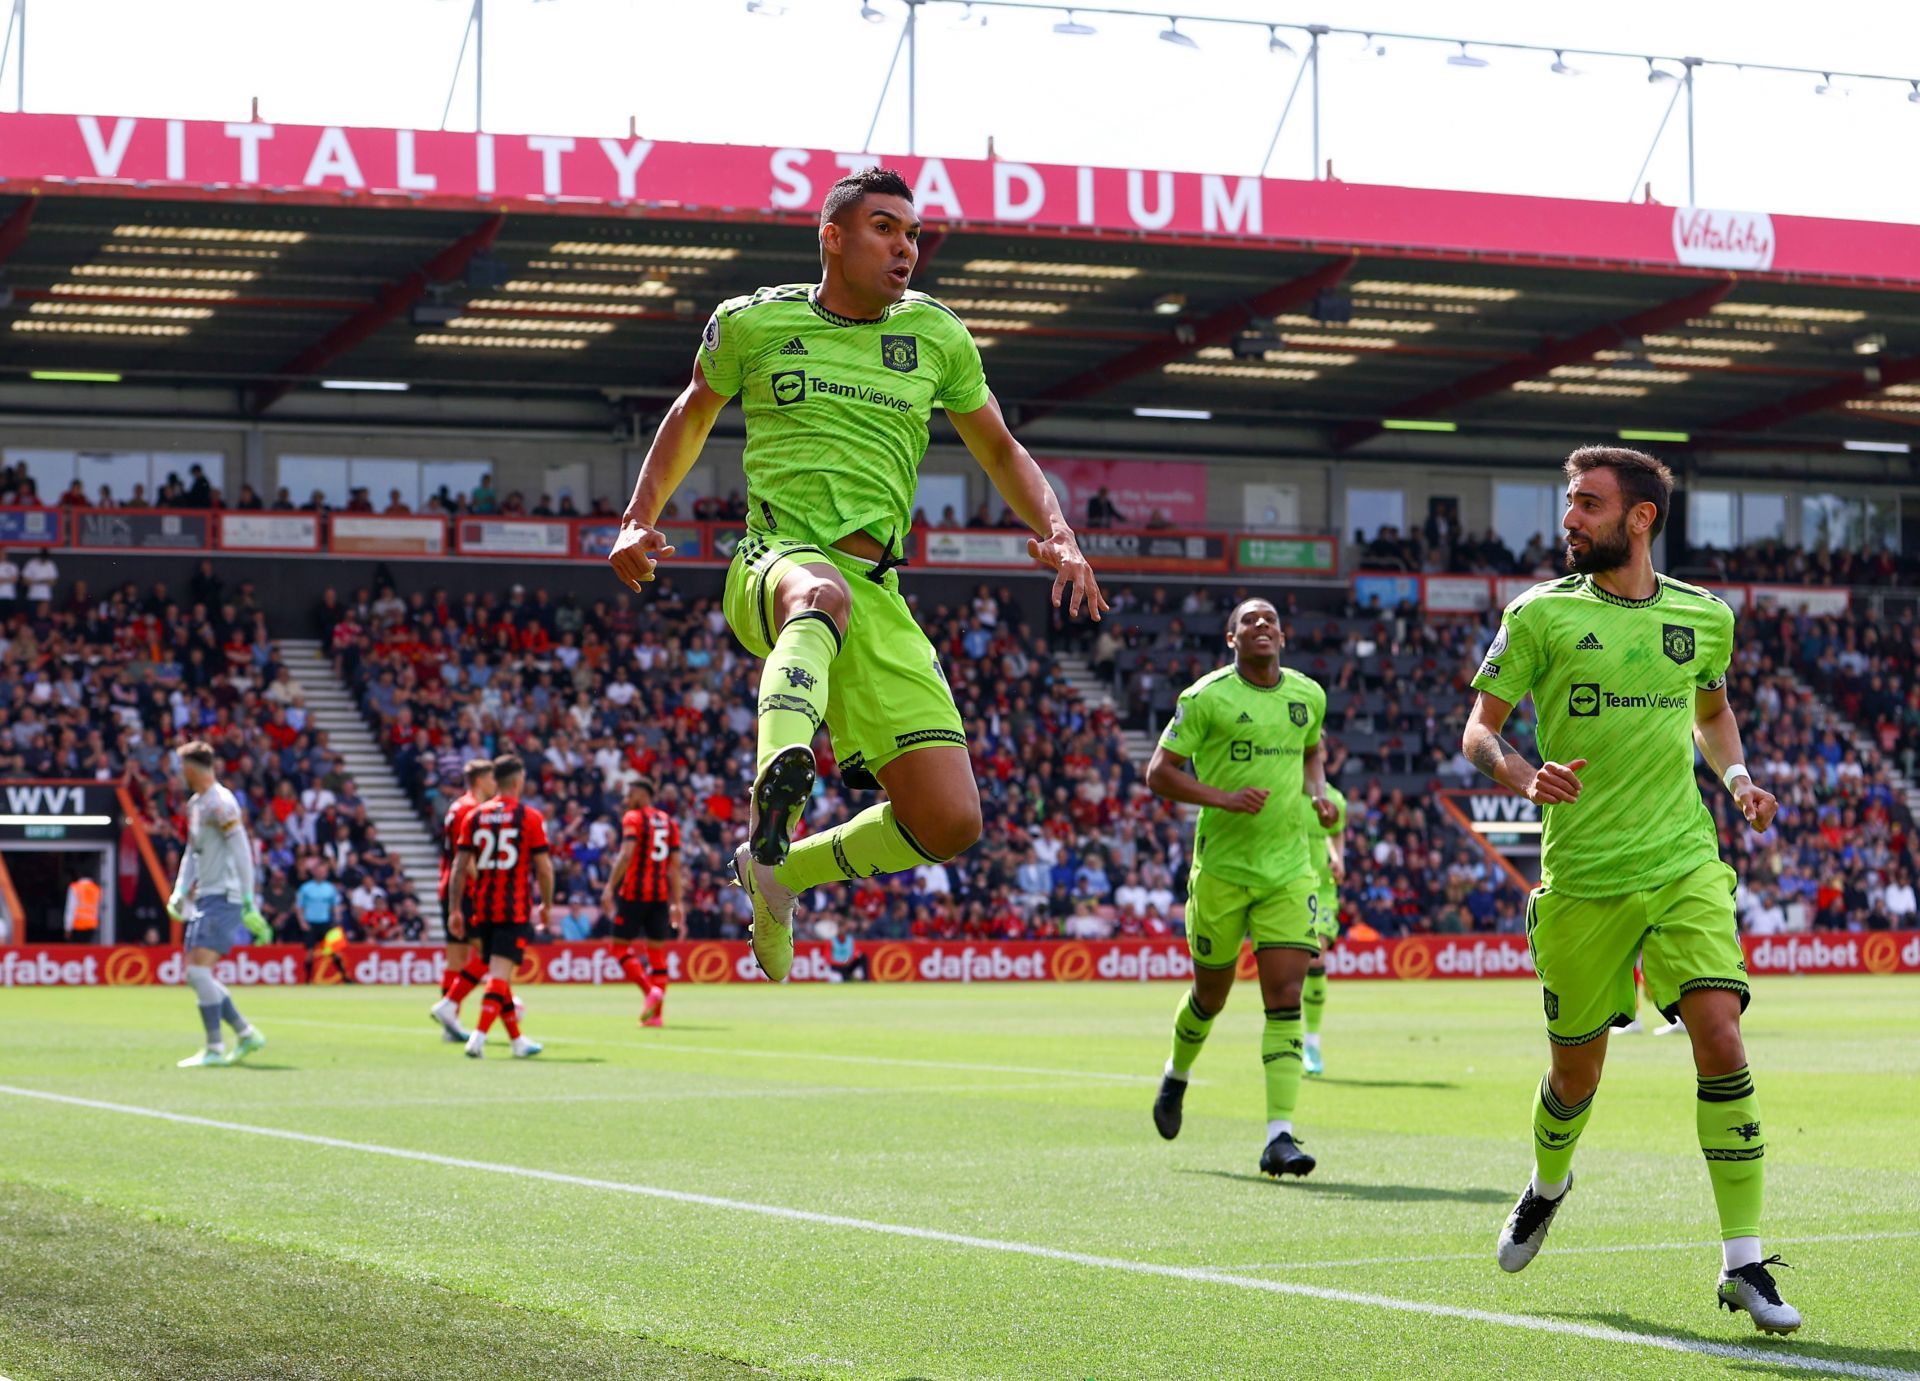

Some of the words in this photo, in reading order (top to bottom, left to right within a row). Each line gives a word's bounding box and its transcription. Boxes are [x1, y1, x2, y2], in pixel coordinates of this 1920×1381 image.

[77, 116, 654, 198] VITALITY
[769, 147, 1263, 235] STADIUM
[1679, 209, 1769, 269] Vitality
[808, 377, 913, 414] TeamViewer
[1603, 692, 1688, 709] TeamViewer
[6, 786, 85, 815] WV1
[1469, 795, 1537, 822] WV2
[472, 828, 518, 870] 25
[650, 829, 669, 862] 5
[1308, 894, 1317, 924] 9
[157, 951, 298, 985] dabet
[354, 951, 449, 986] dafab
[547, 949, 682, 986] dafat
[919, 946, 1046, 984] dafabet
[1097, 946, 1195, 983] dafab
[1752, 937, 1859, 973] dafabet
